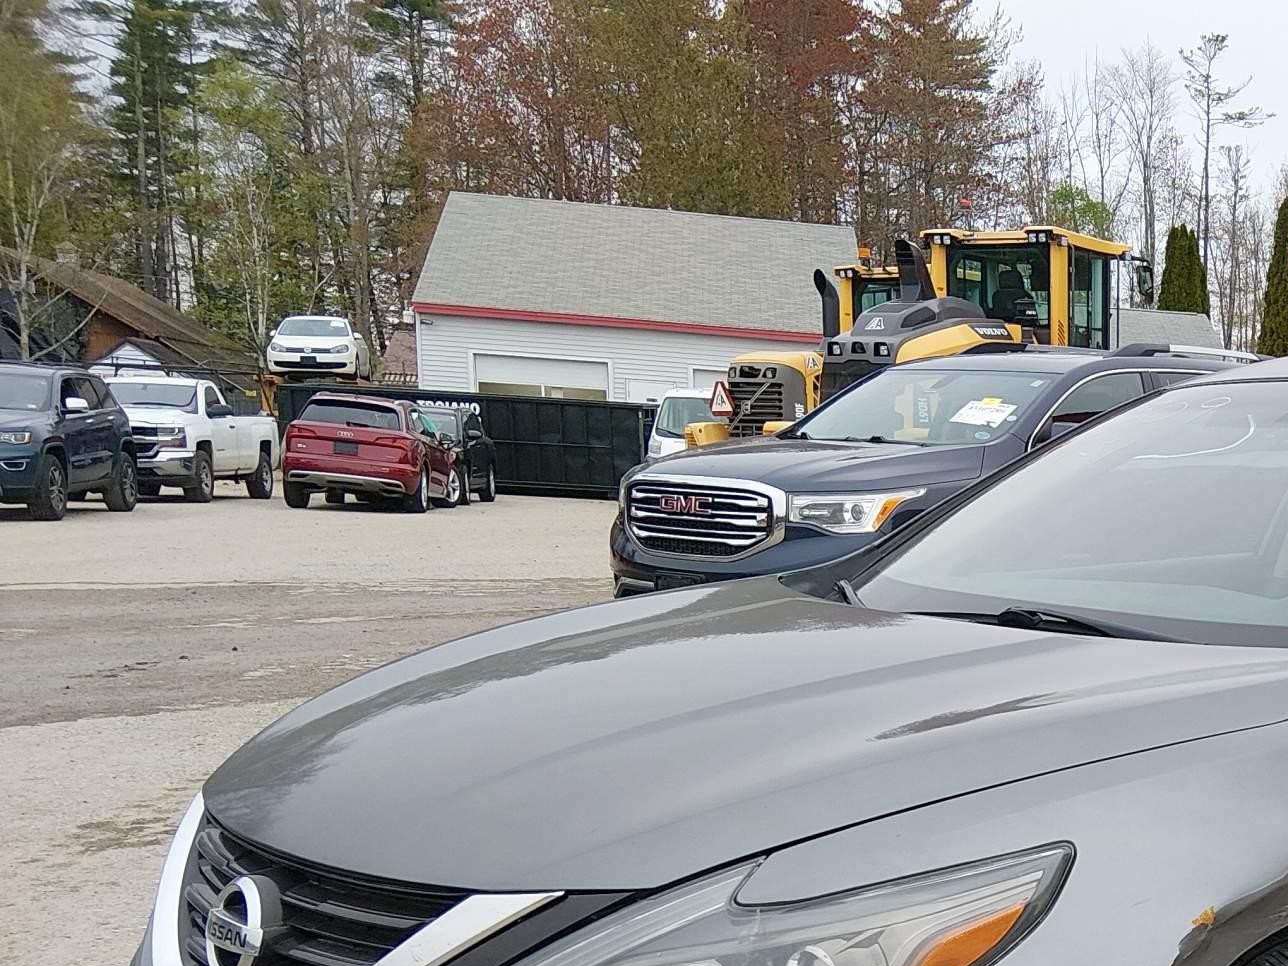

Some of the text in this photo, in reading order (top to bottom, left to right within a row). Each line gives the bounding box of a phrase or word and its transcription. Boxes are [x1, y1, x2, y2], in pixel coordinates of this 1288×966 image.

[974, 327, 1008, 336] VOLVO
[795, 402, 805, 421] 90F
[660, 494, 713, 515] GMC
[210, 921, 248, 949] SSAN
